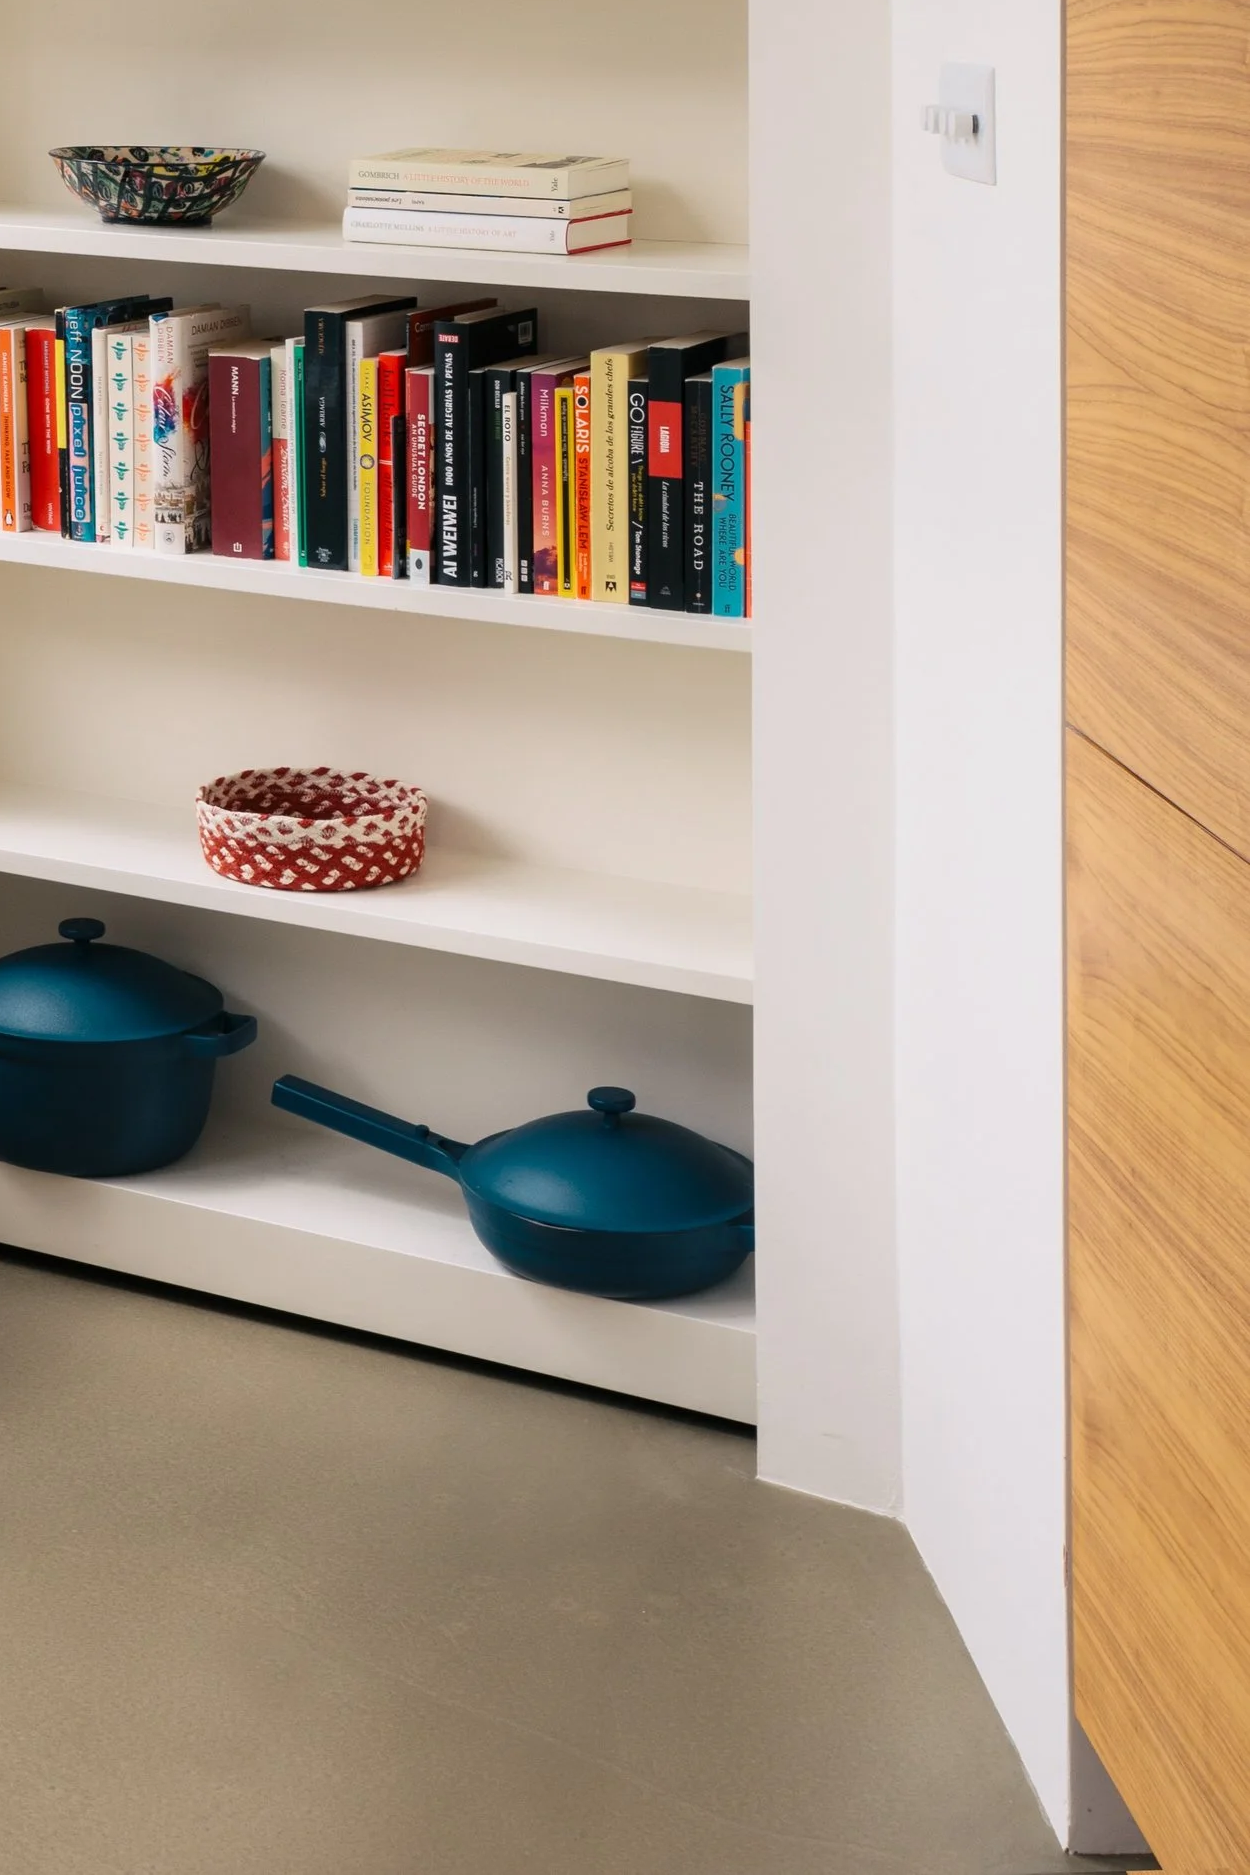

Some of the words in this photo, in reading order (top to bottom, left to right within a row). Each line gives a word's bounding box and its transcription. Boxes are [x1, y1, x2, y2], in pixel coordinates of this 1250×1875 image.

[358, 170, 399, 180] GOMBRICH
[434, 175, 469, 185] HISTORY
[471, 176, 480, 185] OF
[481, 177, 500, 186] THE
[500, 178, 529, 187] WORLD
[551, 177, 559, 193] Yale
[351, 220, 393, 230] CHARLOTTE
[393, 223, 425, 232] MULLINS
[67, 315, 82, 343] jeff
[191, 320, 219, 335] DAMIAN
[70, 349, 83, 399] NOON
[445, 352, 453, 379] PENAS
[605, 358, 613, 382] chefs
[444, 390, 453, 428] ALEGRÍAS
[505, 405, 511, 415] EL
[540, 389, 549, 437] Milkman
[605, 384, 614, 419] grandes
[630, 393, 644, 423] GO
[720, 385, 735, 429] SALLY
[71, 405, 87, 457] pixel
[361, 393, 372, 442] ASIMOV
[411, 424, 417, 434] AN
[575, 385, 589, 453] SOLARIS
[606, 421, 614, 434] los
[417, 414, 425, 457] SECRET
[444, 429, 453, 440] DE
[606, 436, 614, 446] de
[444, 443, 453, 464] AÑOS
[606, 448, 614, 477] alcoba
[720, 433, 735, 502] ROONEY
[417, 460, 426, 509] LONDON
[445, 466, 453, 485] 1000
[541, 465, 549, 495] ANNA
[579, 457, 588, 522] STANISŁAW
[606, 480, 614, 491] de
[72, 465, 87, 521] juice
[661, 489, 669, 512] ciudad
[694, 482, 703, 515] THE
[442, 494, 458, 557] WEIWEI
[542, 500, 550, 536] BURNS
[606, 494, 614, 531] Secretos
[661, 513, 669, 521] de
[661, 522, 669, 531] los
[579, 525, 588, 549] LEM
[634, 531, 642, 543] Tom
[718, 517, 727, 544] WHERE
[728, 514, 736, 557] BEAUTIFUL
[634, 544, 642, 575] Standage
[694, 524, 703, 570] ROAD
[718, 550, 727, 565] ARE
[442, 560, 457, 578] AI
[718, 569, 727, 588] YOU
[728, 560, 737, 592] WORLD,
